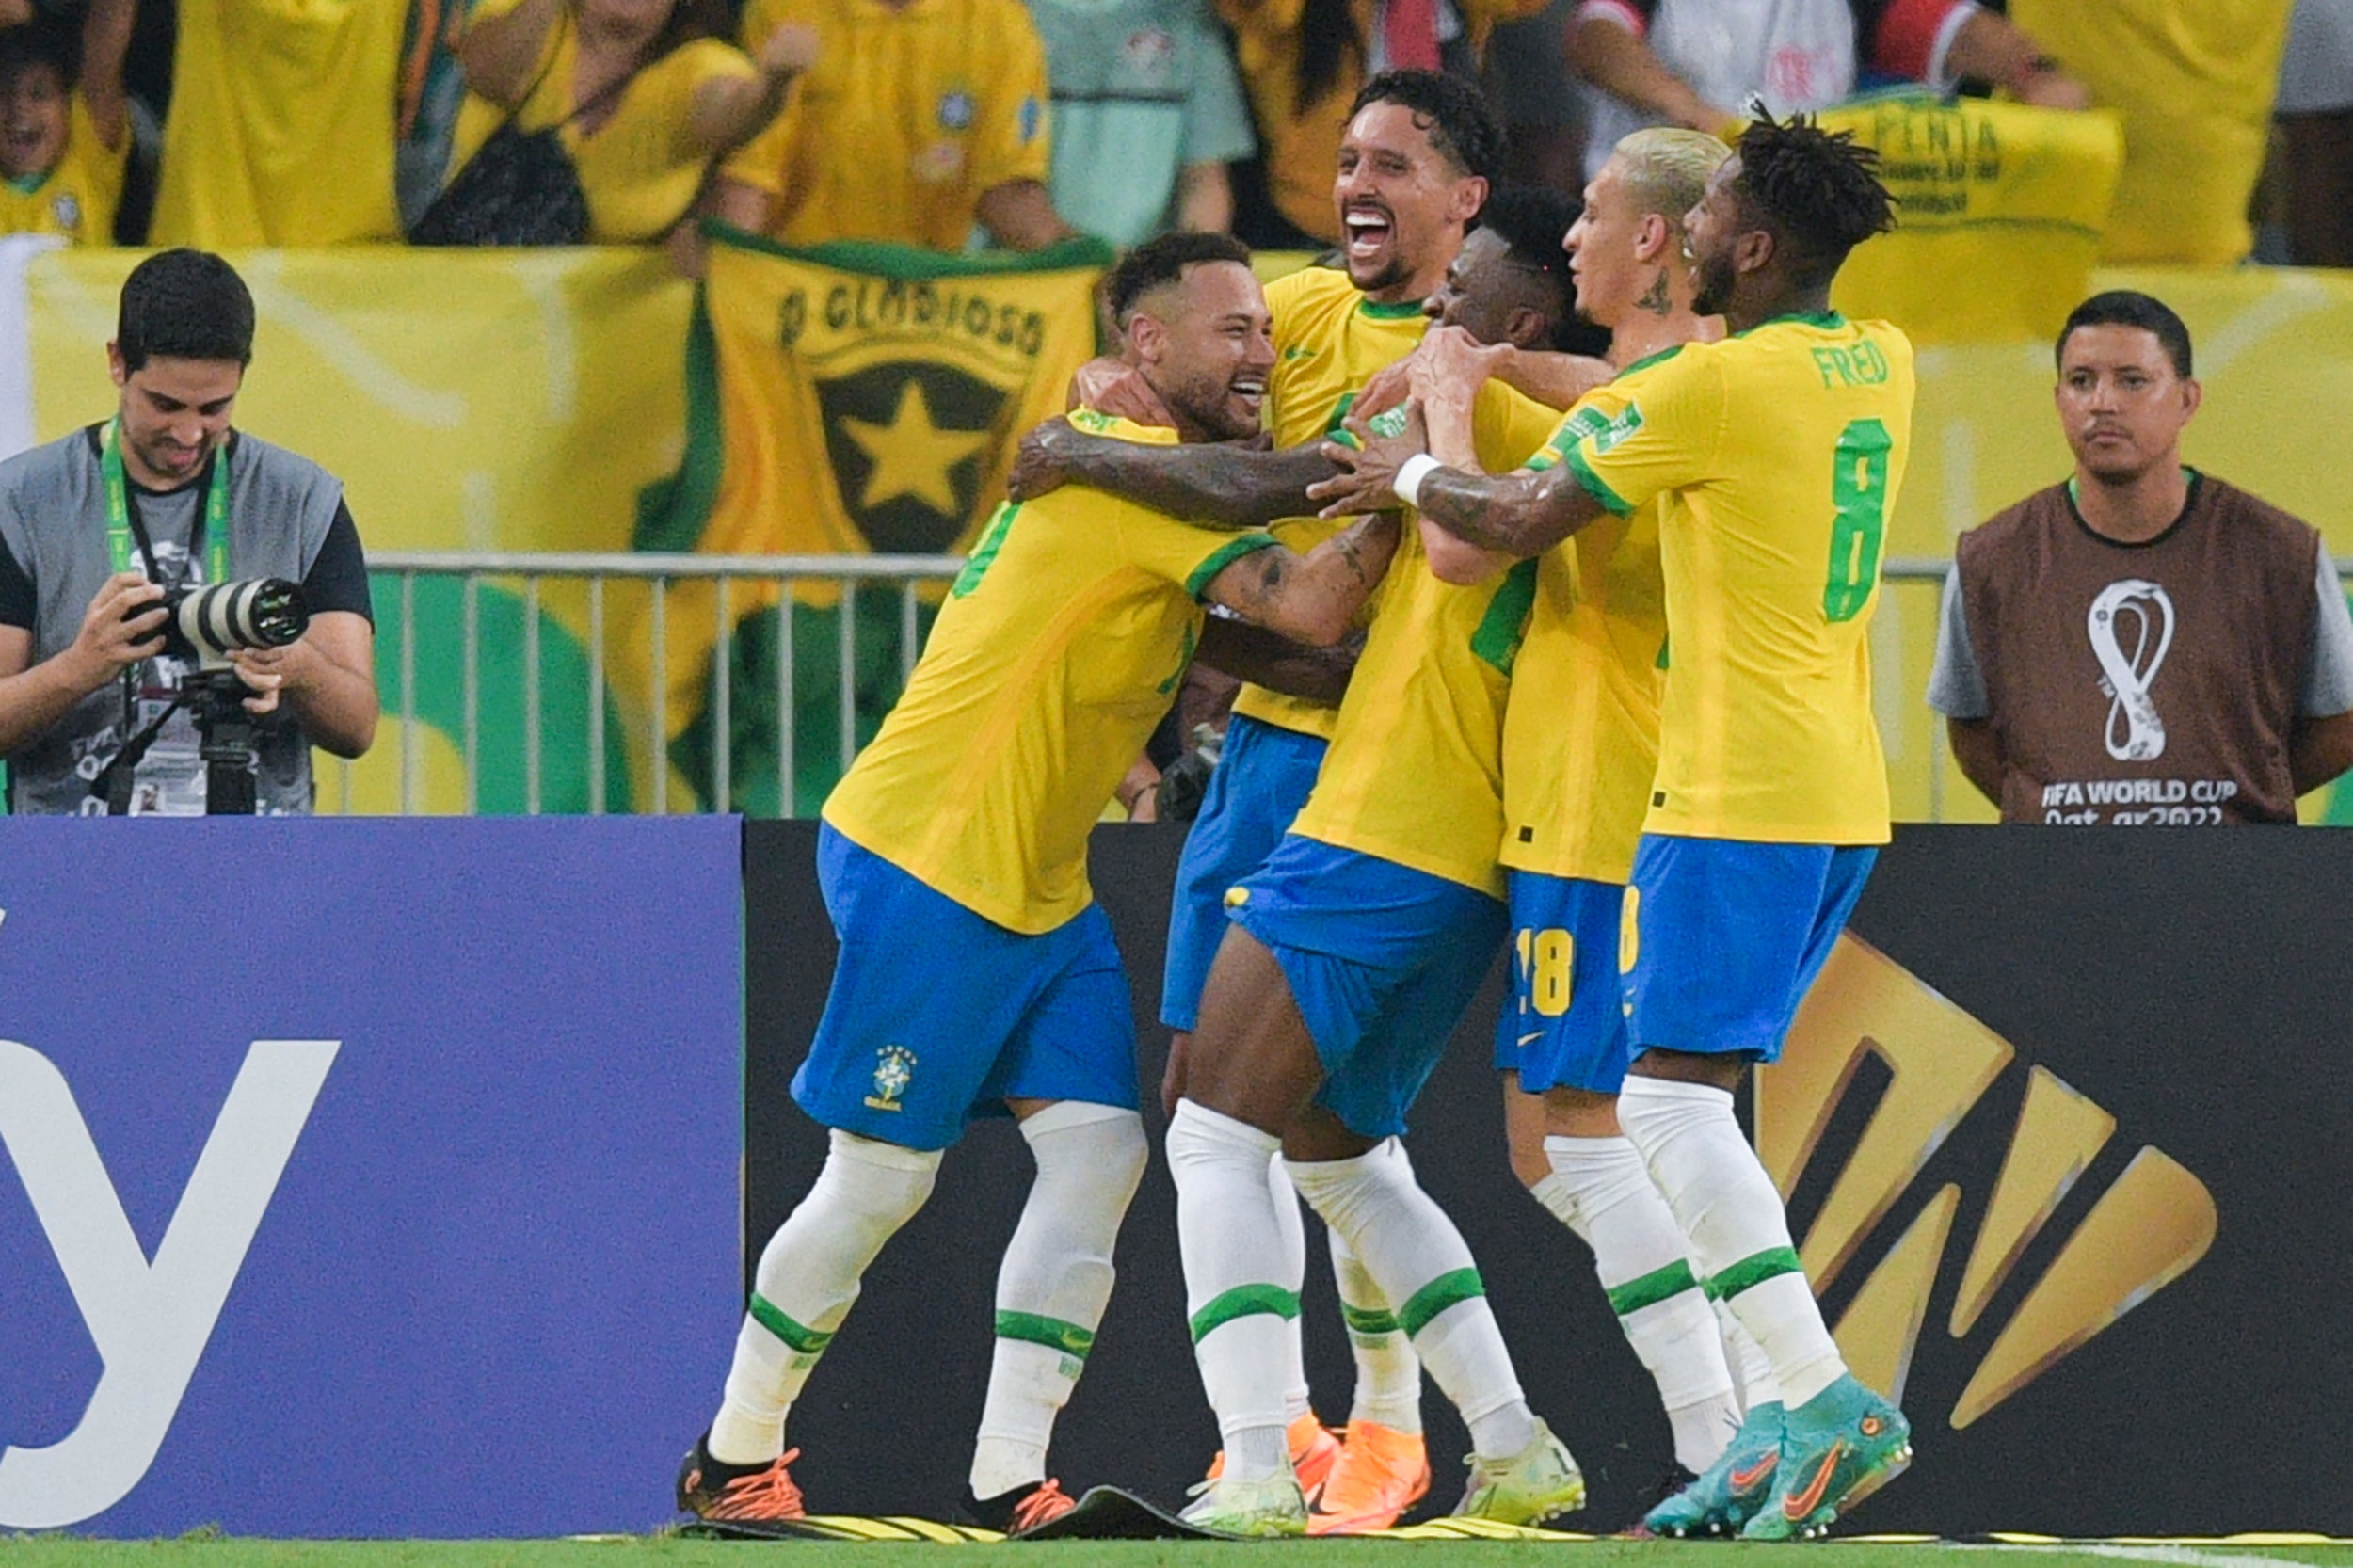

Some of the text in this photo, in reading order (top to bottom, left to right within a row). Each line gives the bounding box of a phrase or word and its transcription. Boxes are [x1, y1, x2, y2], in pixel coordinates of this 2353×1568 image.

[1812, 339, 1888, 390] FRED
[1823, 419, 1893, 623] 8
[2087, 780, 2186, 803] WORLD
[2191, 780, 2238, 801] CUP
